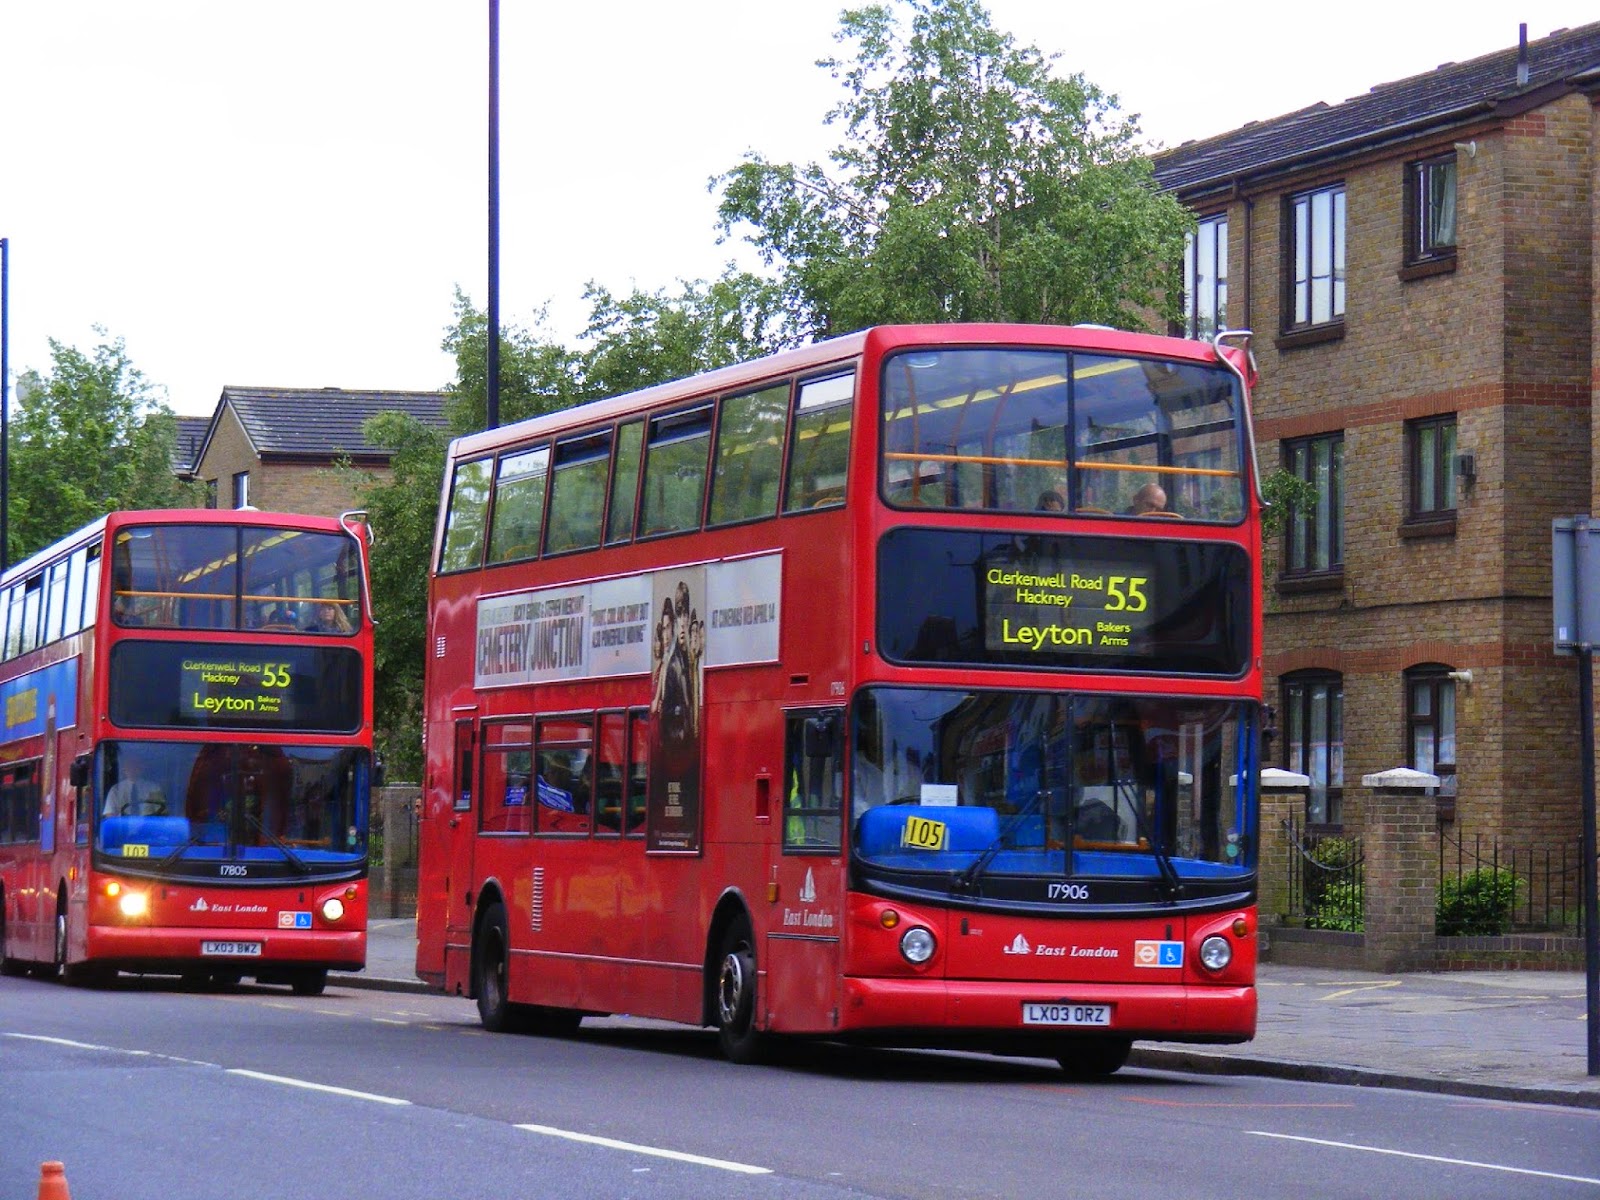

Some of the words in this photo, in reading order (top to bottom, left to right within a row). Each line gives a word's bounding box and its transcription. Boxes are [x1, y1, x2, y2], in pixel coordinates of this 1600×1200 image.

[987, 568, 1066, 588] Clerkenwell
[1071, 574, 1103, 590] Road
[1016, 588, 1073, 608] Hackney
[1104, 576, 1148, 612] 55
[1003, 619, 1093, 650] Leyton
[1096, 622, 1131, 633] Bakers
[479, 623, 531, 675] CEMETERY
[531, 616, 584, 671] JUNCTION
[1100, 636, 1129, 646] Arms
[182, 660, 236, 672] Clerkenwell
[238, 662, 261, 673] Road
[202, 672, 240, 685] Hackney
[261, 663, 291, 687] 55
[194, 692, 255, 713] Leyton
[257, 695, 281, 704] Bakers
[259, 704, 280, 712] Arms
[909, 819, 942, 846] 105
[220, 865, 248, 876] 17805
[1047, 883, 1089, 899] 17906
[211, 903, 232, 912] East
[235, 904, 268, 912] London
[783, 908, 801, 926] East
[803, 909, 833, 928] London
[206, 942, 234, 952] LX03
[237, 943, 258, 953] BWZ
[1035, 945, 1066, 956] East
[1069, 945, 1118, 957] London
[1029, 1006, 1069, 1021] LX03
